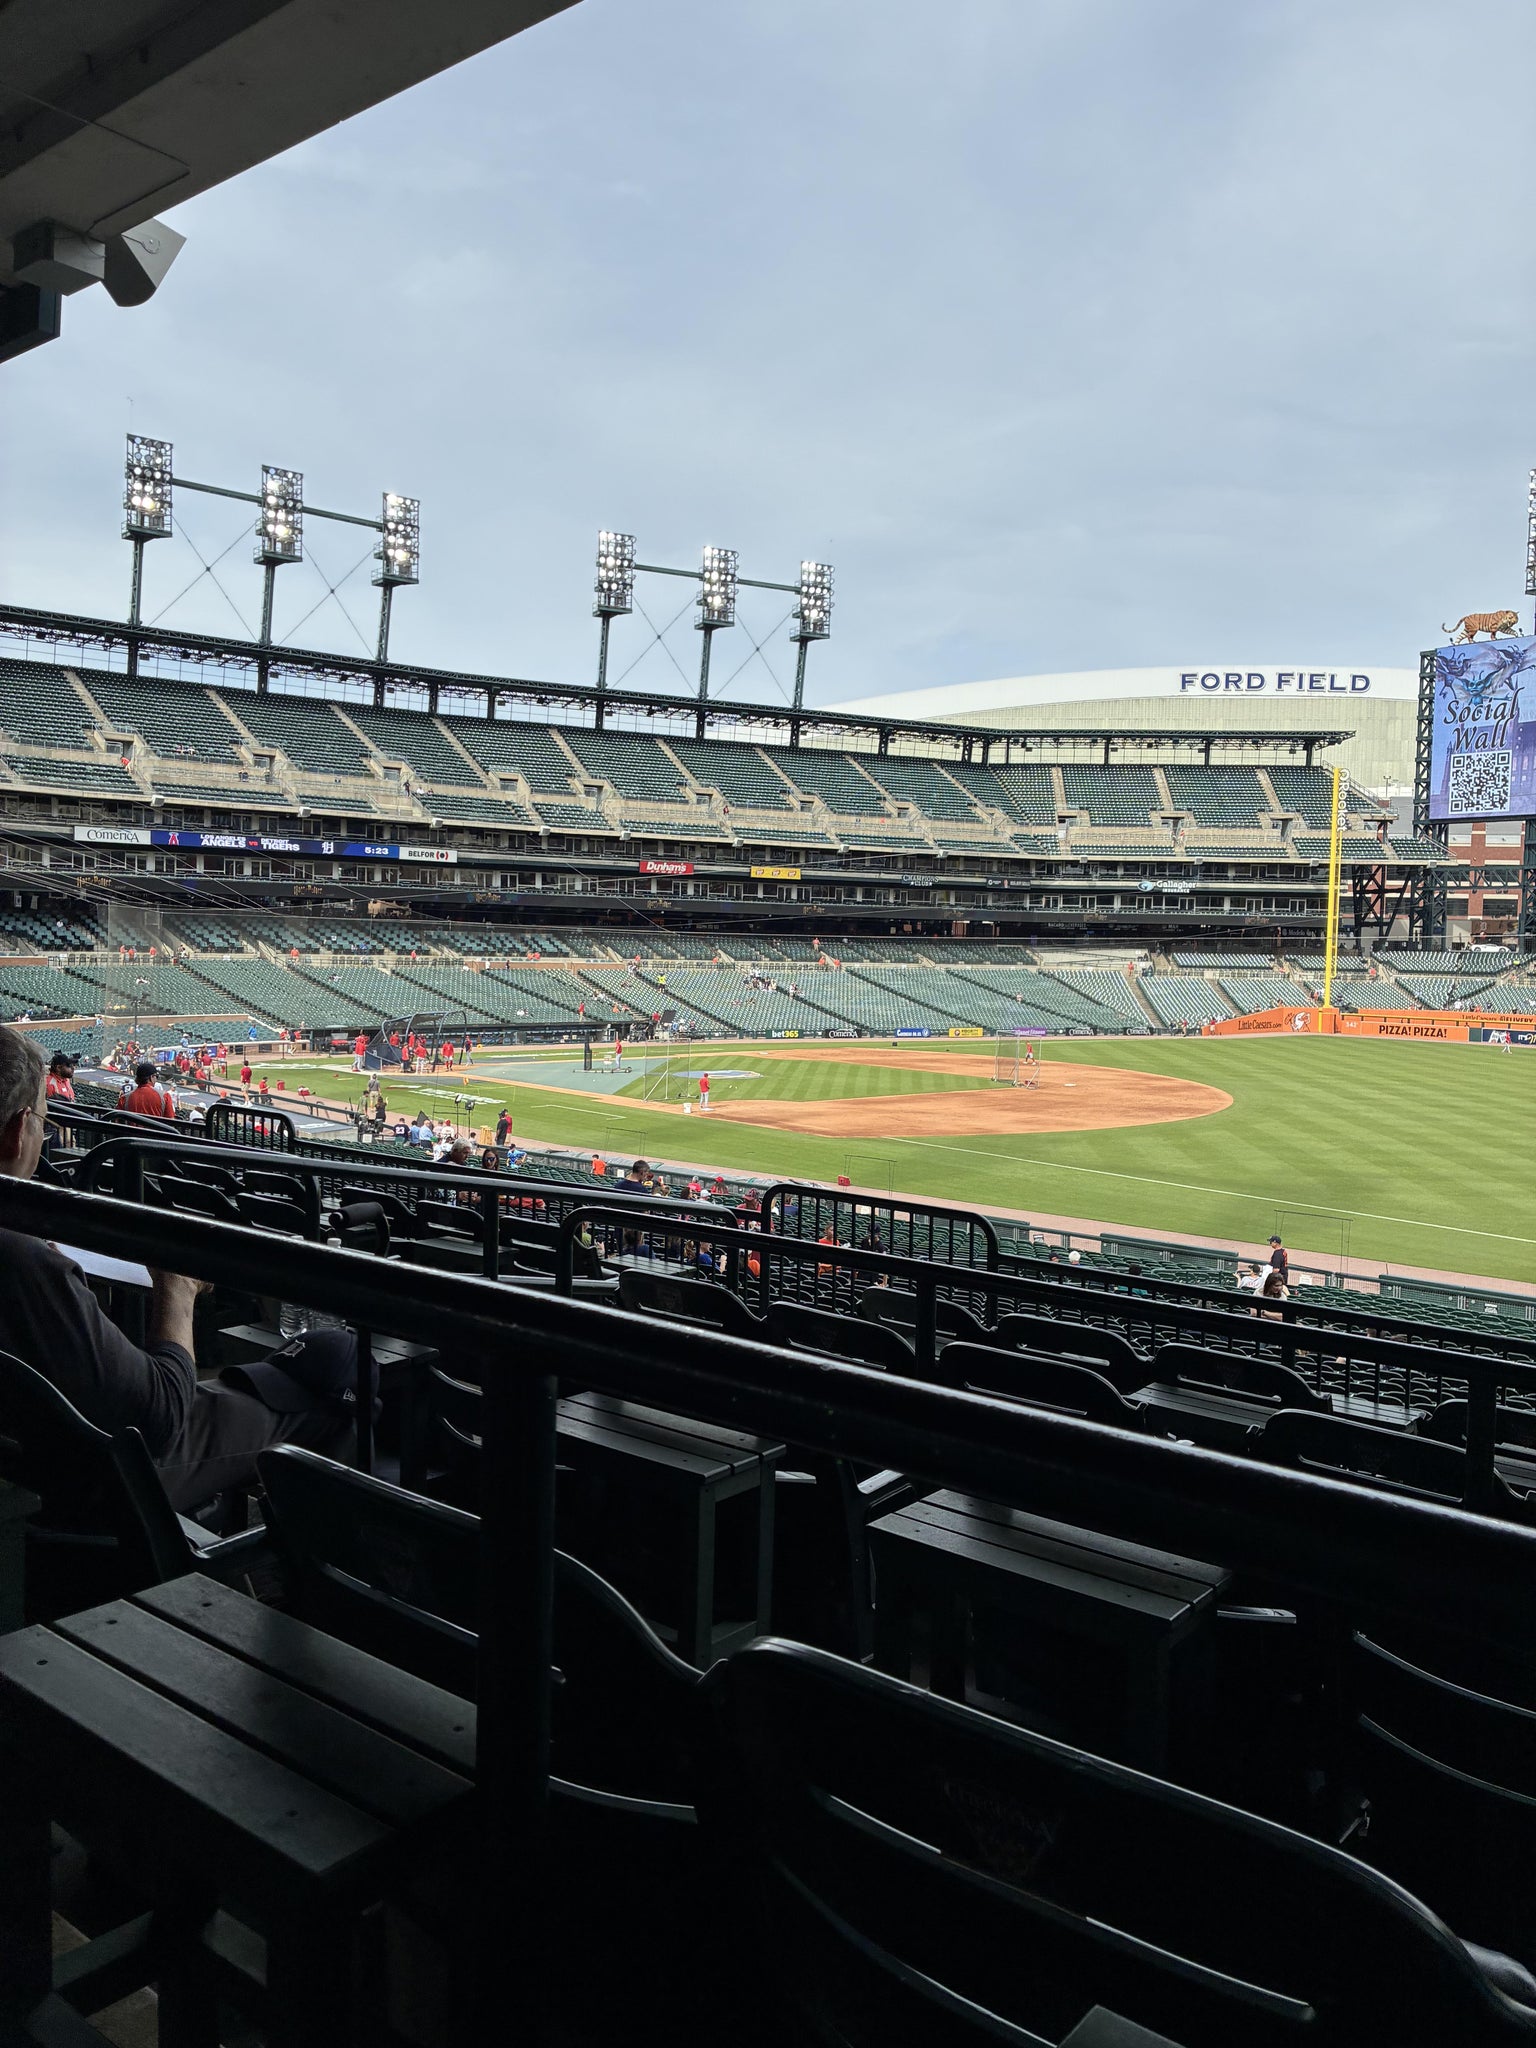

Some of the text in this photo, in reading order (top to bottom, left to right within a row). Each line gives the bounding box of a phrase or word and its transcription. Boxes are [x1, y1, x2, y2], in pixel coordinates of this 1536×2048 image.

[1180, 672, 1371, 694] FORD FIELD
[1443, 687, 1525, 725] Social
[1452, 717, 1511, 751] Wall
[201, 839, 246, 848] ANGELS
[262, 843, 300, 851] TIGERS
[364, 846, 389, 855] 5:23
[408, 850, 435, 858] BELFOR
[646, 861, 687, 873] Dunham's
[1156, 880, 1197, 890] Gallagher
[772, 1030, 799, 1038] bet365
[1378, 1024, 1448, 1038] PIZZA! PIZZA!
[395, 1126, 405, 1135] 23
